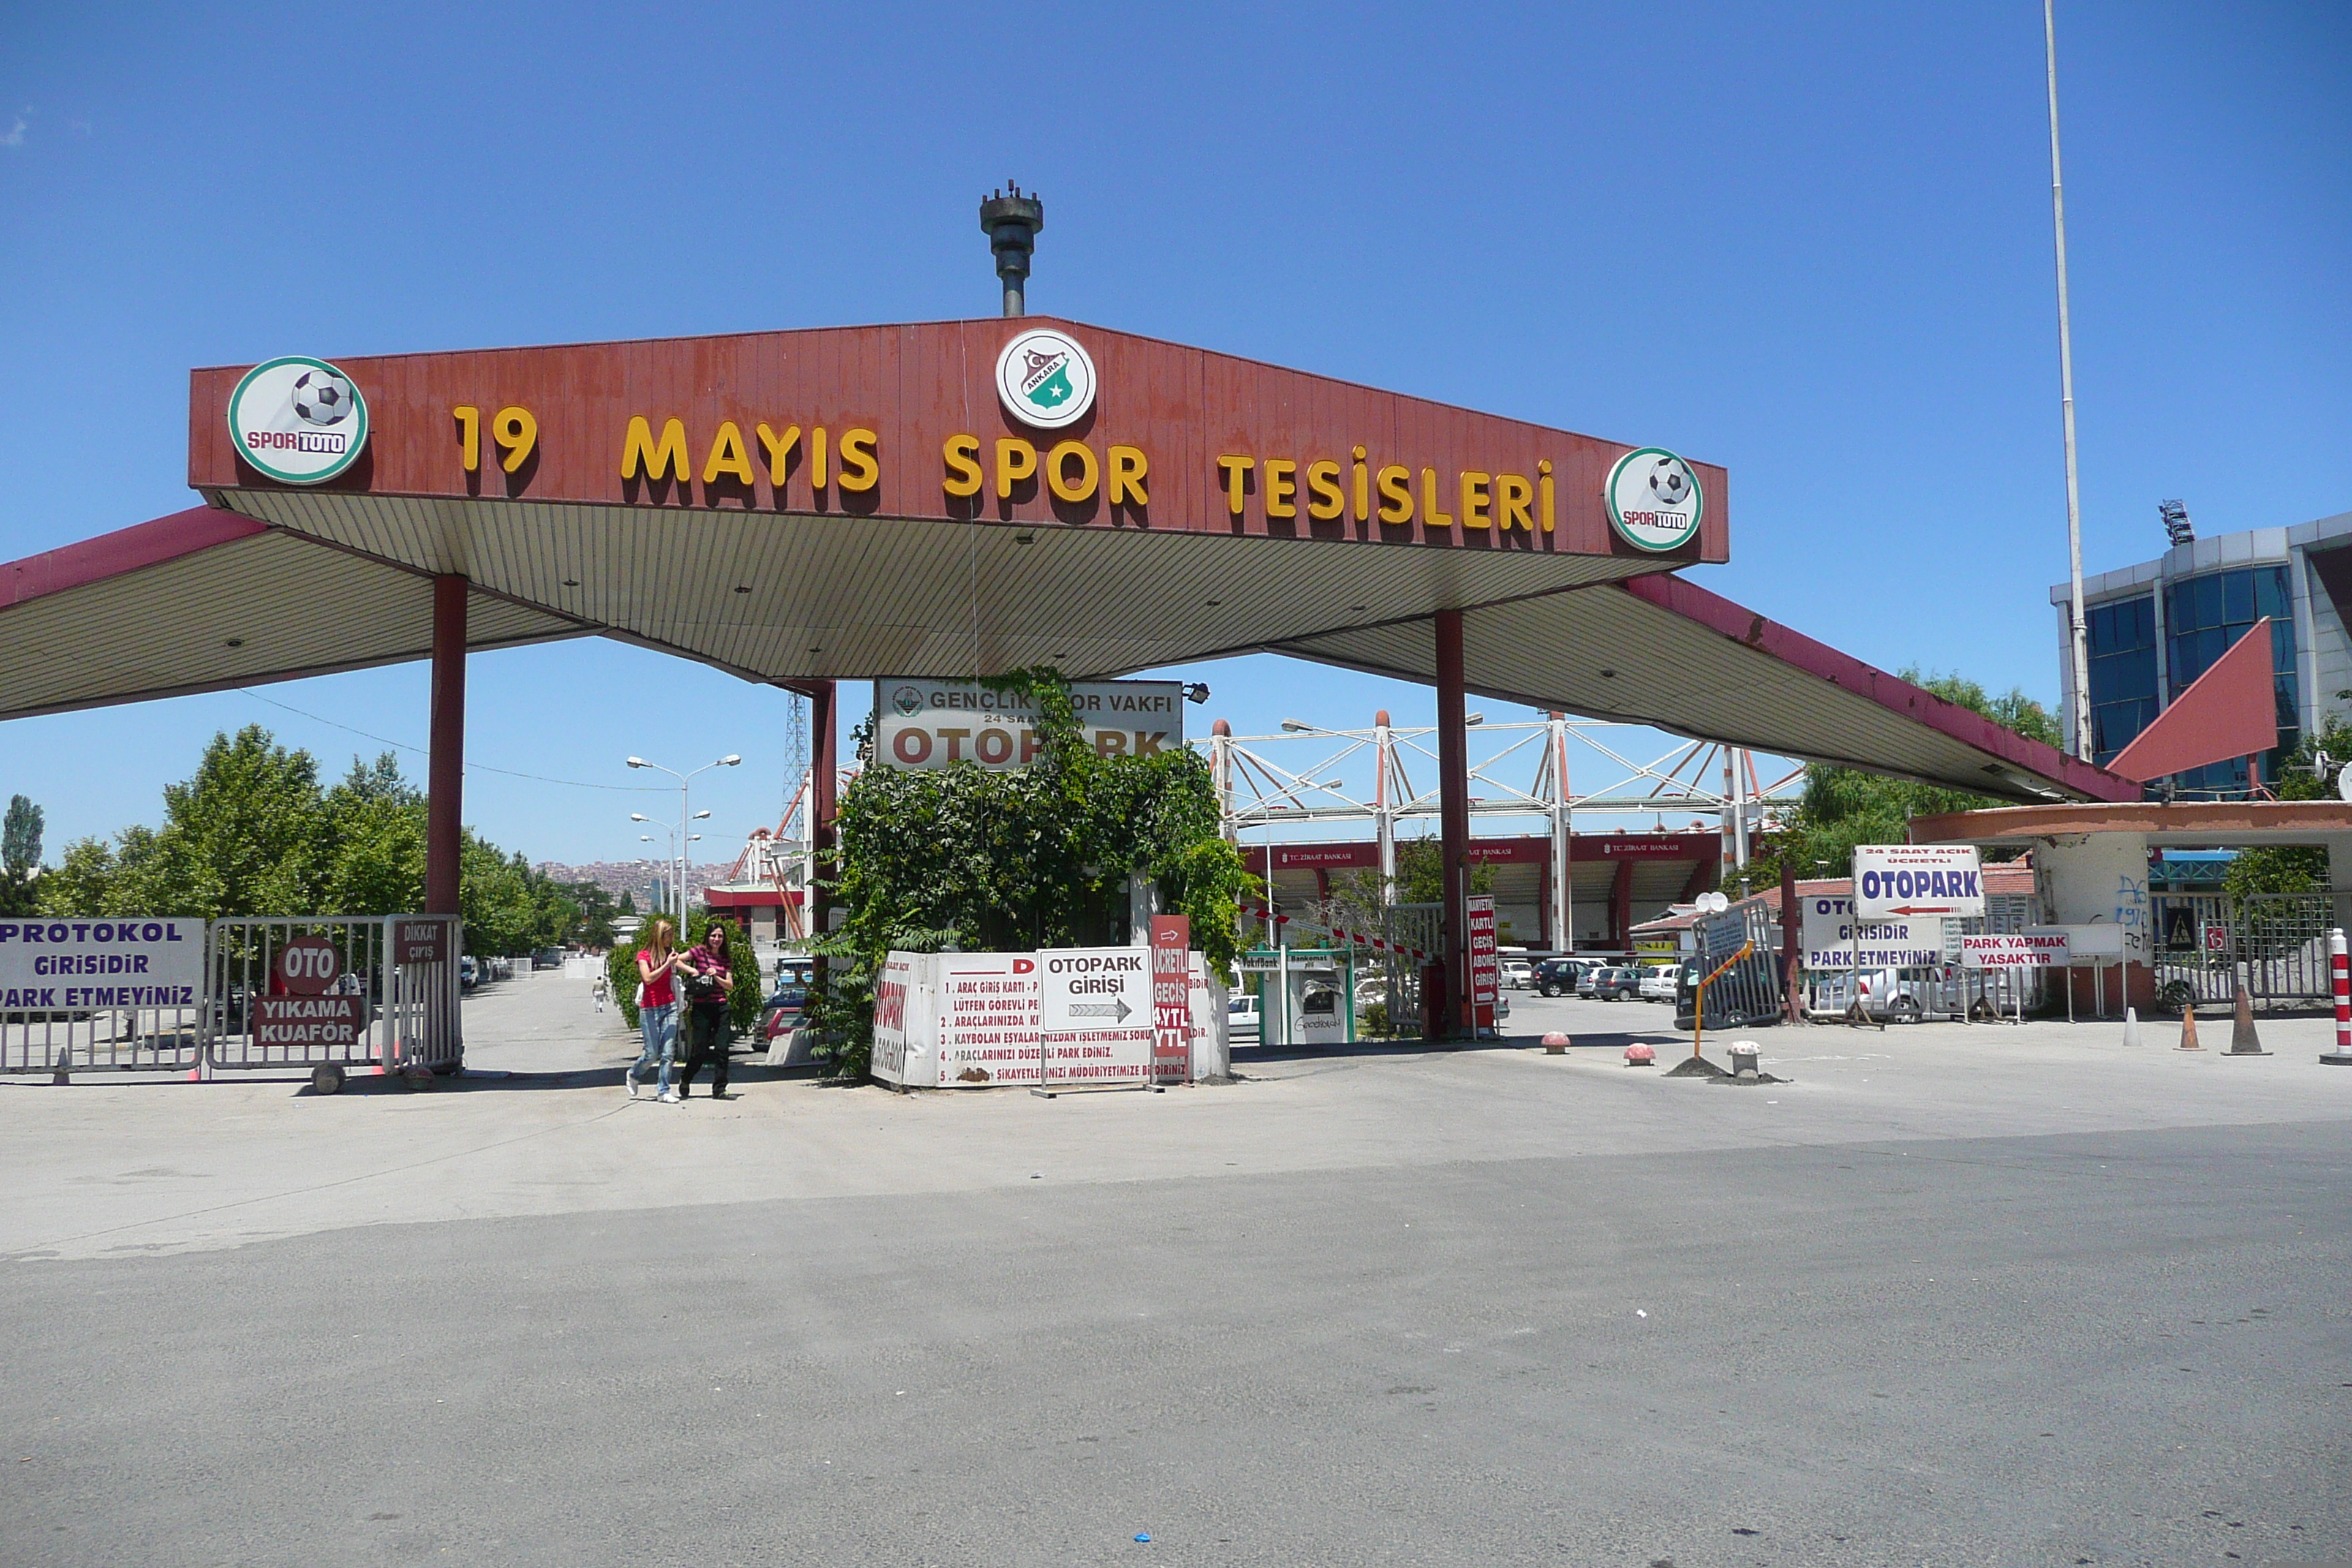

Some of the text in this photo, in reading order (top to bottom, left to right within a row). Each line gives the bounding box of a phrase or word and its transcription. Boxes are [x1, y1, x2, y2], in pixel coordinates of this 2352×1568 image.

[1027, 361, 1060, 390] ANKARA
[247, 431, 344, 453] SPOR TOTO
[453, 405, 538, 473] 19
[620, 414, 879, 492] MAYIS
[942, 433, 1149, 505] SPOR
[1623, 510, 1686, 529] SPOR TOTO
[1108, 695, 1172, 712] VAKFI
[984, 715, 1001, 723] 24
[893, 727, 1169, 764] OTOPRK
[1861, 870, 1980, 900] OTOPARK
[0, 923, 183, 943] PROTOKOL
[1470, 917, 1494, 930] KARTLI
[1964, 938, 2002, 949] PARK
[2005, 936, 2067, 948] YAPMAK
[285, 946, 334, 979] OTO
[1049, 957, 1142, 973] OTOPARK
[1473, 954, 1496, 968] ABONE
[1811, 951, 1852, 966] PARK
[1978, 953, 2051, 965] YASAKTIR
[957, 981, 977, 997] ARAÇ
[1003, 981, 1025, 993] KARTI
[1068, 974, 1125, 997] GİRİŞİ
[1155, 979, 1186, 1006] GEÇİŞ
[0, 988, 56, 1007] ARK
[954, 997, 985, 1011] LÜTFEN
[262, 1000, 352, 1019] YIKAMA
[260, 1021, 353, 1042] KUAFÖR
[954, 1014, 1025, 1030] ARAÇLARINIZDA
[955, 1032, 1000, 1045] KAYBOLAN
[1154, 1028, 1186, 1047] YTL
[955, 1049, 1015, 1063] ARAÇLARINIZI
[1058, 1047, 1079, 1059] PARK
